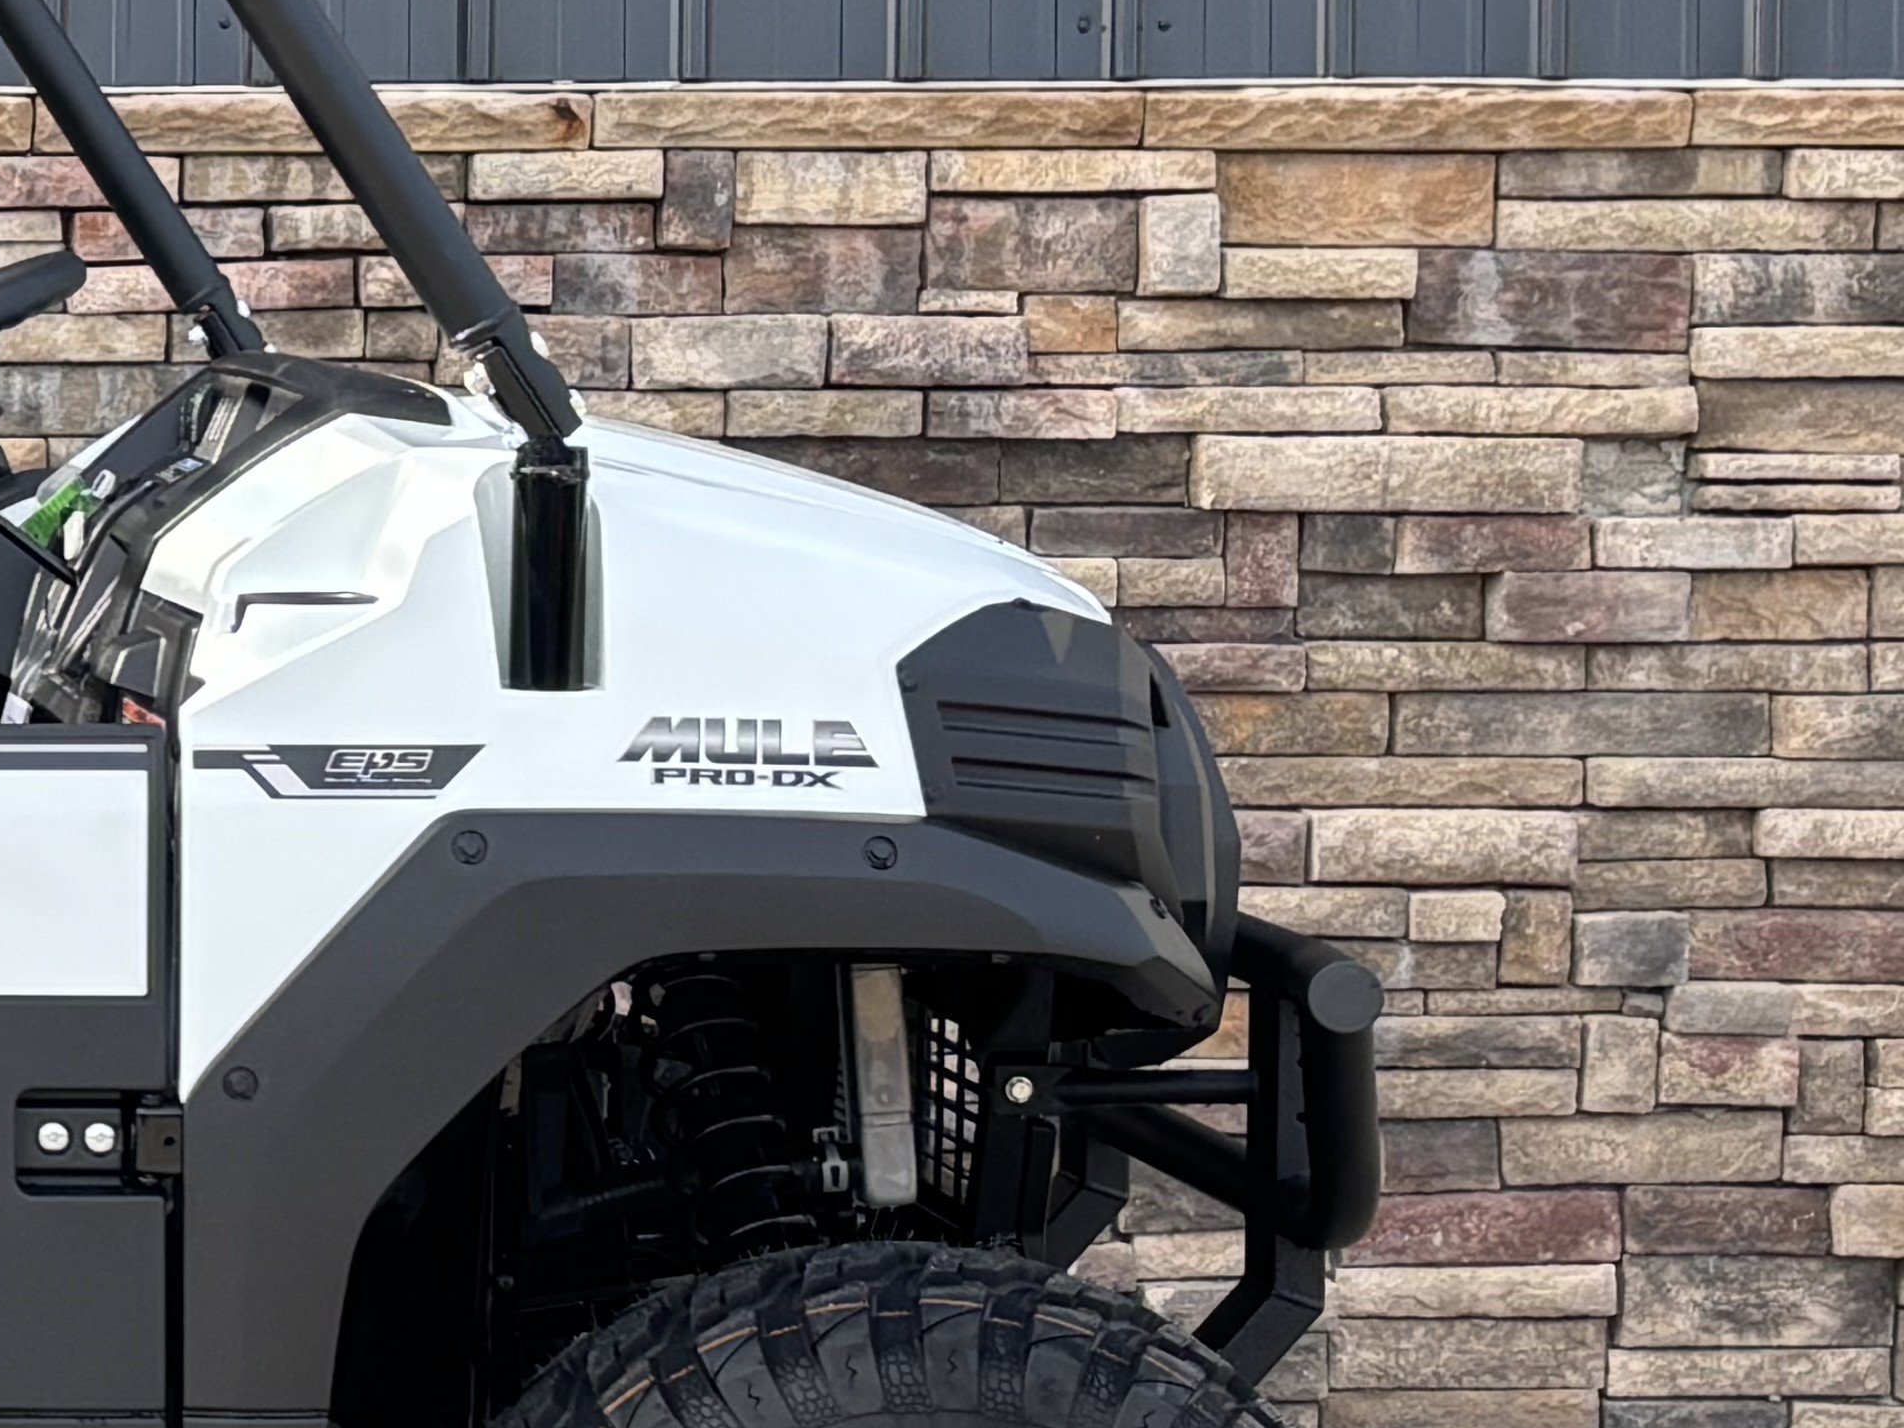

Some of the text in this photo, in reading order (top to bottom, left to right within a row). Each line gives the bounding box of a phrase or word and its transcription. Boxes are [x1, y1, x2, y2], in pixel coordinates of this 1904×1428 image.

[617, 716, 879, 767] MULE
[325, 749, 434, 778] EPS
[652, 767, 844, 790] PRO-DX
